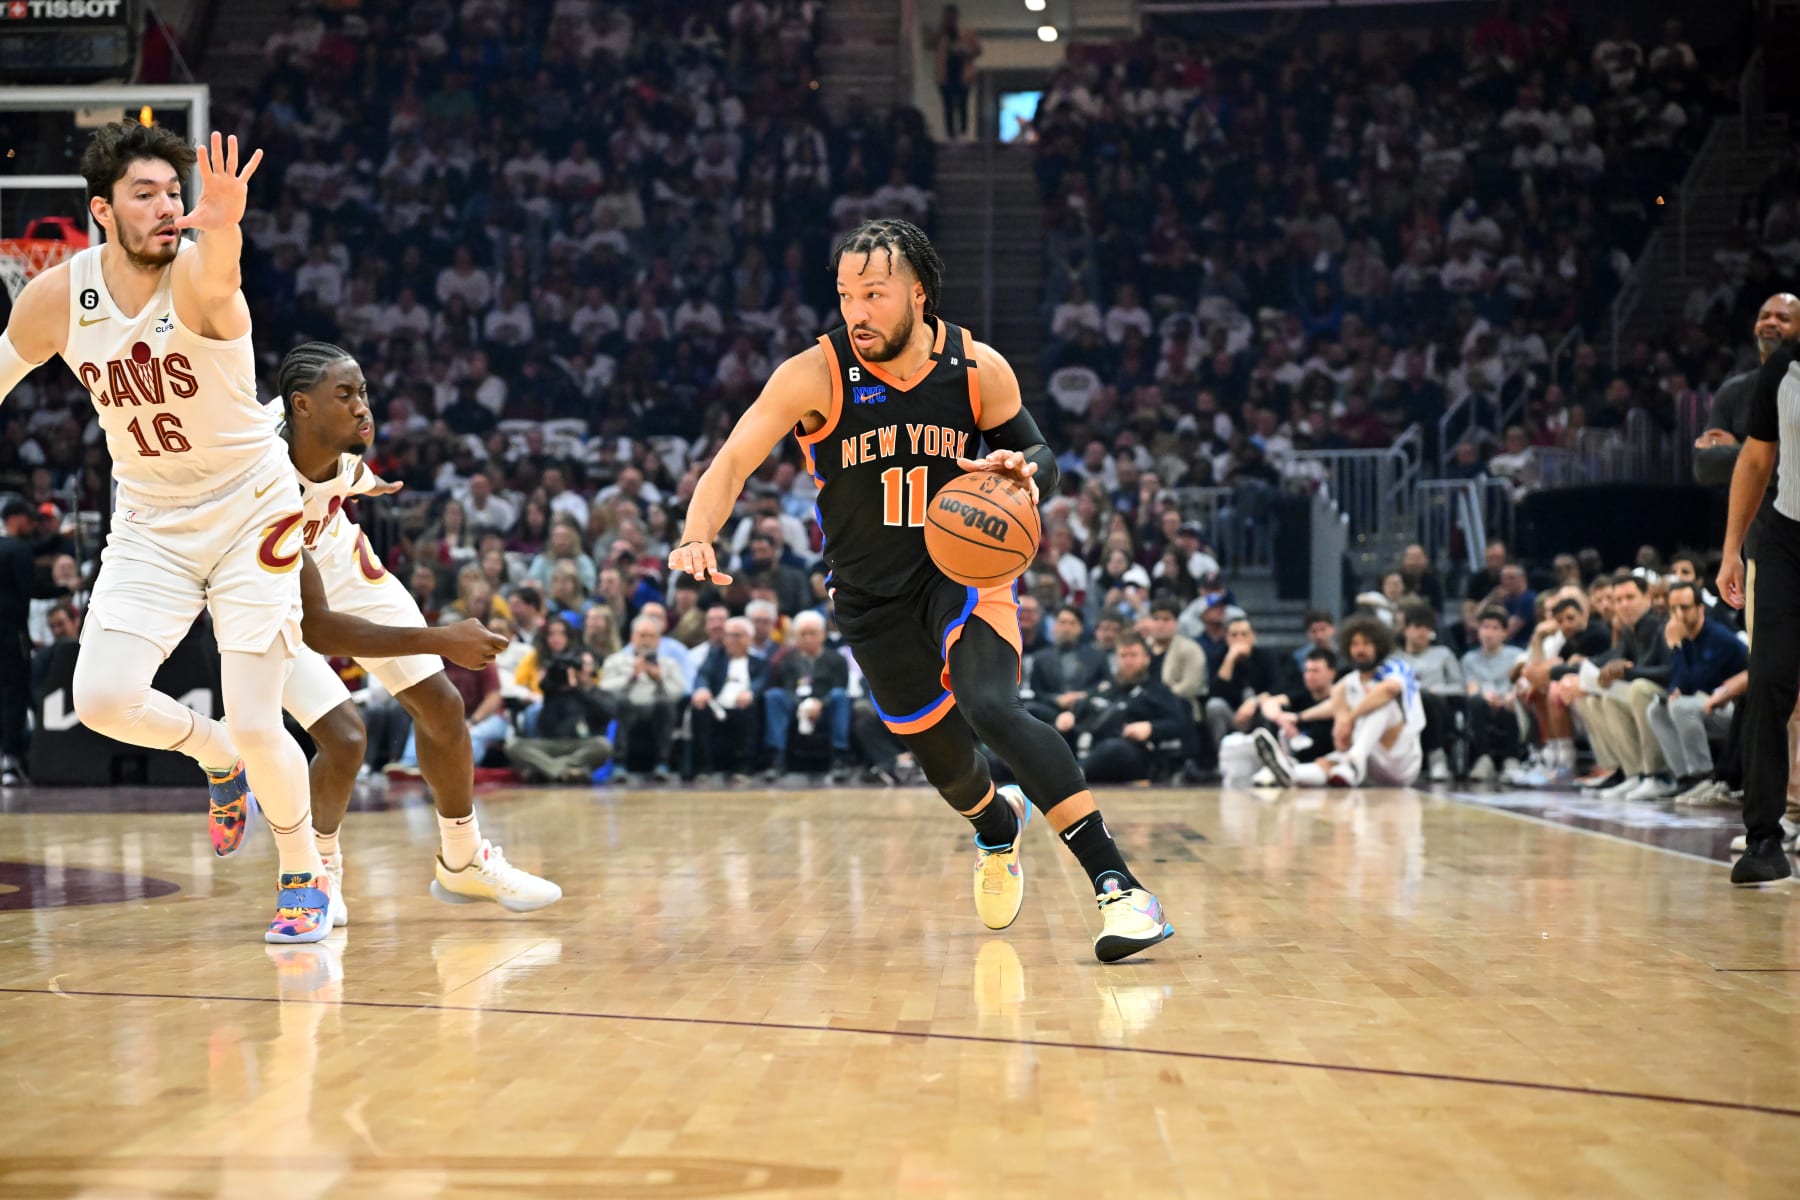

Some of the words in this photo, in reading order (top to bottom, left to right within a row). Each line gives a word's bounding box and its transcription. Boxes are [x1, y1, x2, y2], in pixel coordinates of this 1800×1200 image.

[29, 0, 120, 18] TISSOT
[84, 291, 95, 307] 6
[79, 352, 199, 407] CAVS
[848, 366, 861, 382] 6
[852, 385, 887, 404] NYC
[127, 412, 193, 456] 16
[841, 424, 898, 469] NEW
[905, 423, 969, 460] YORK
[880, 465, 929, 528] 11
[938, 496, 1008, 543] Wilson
